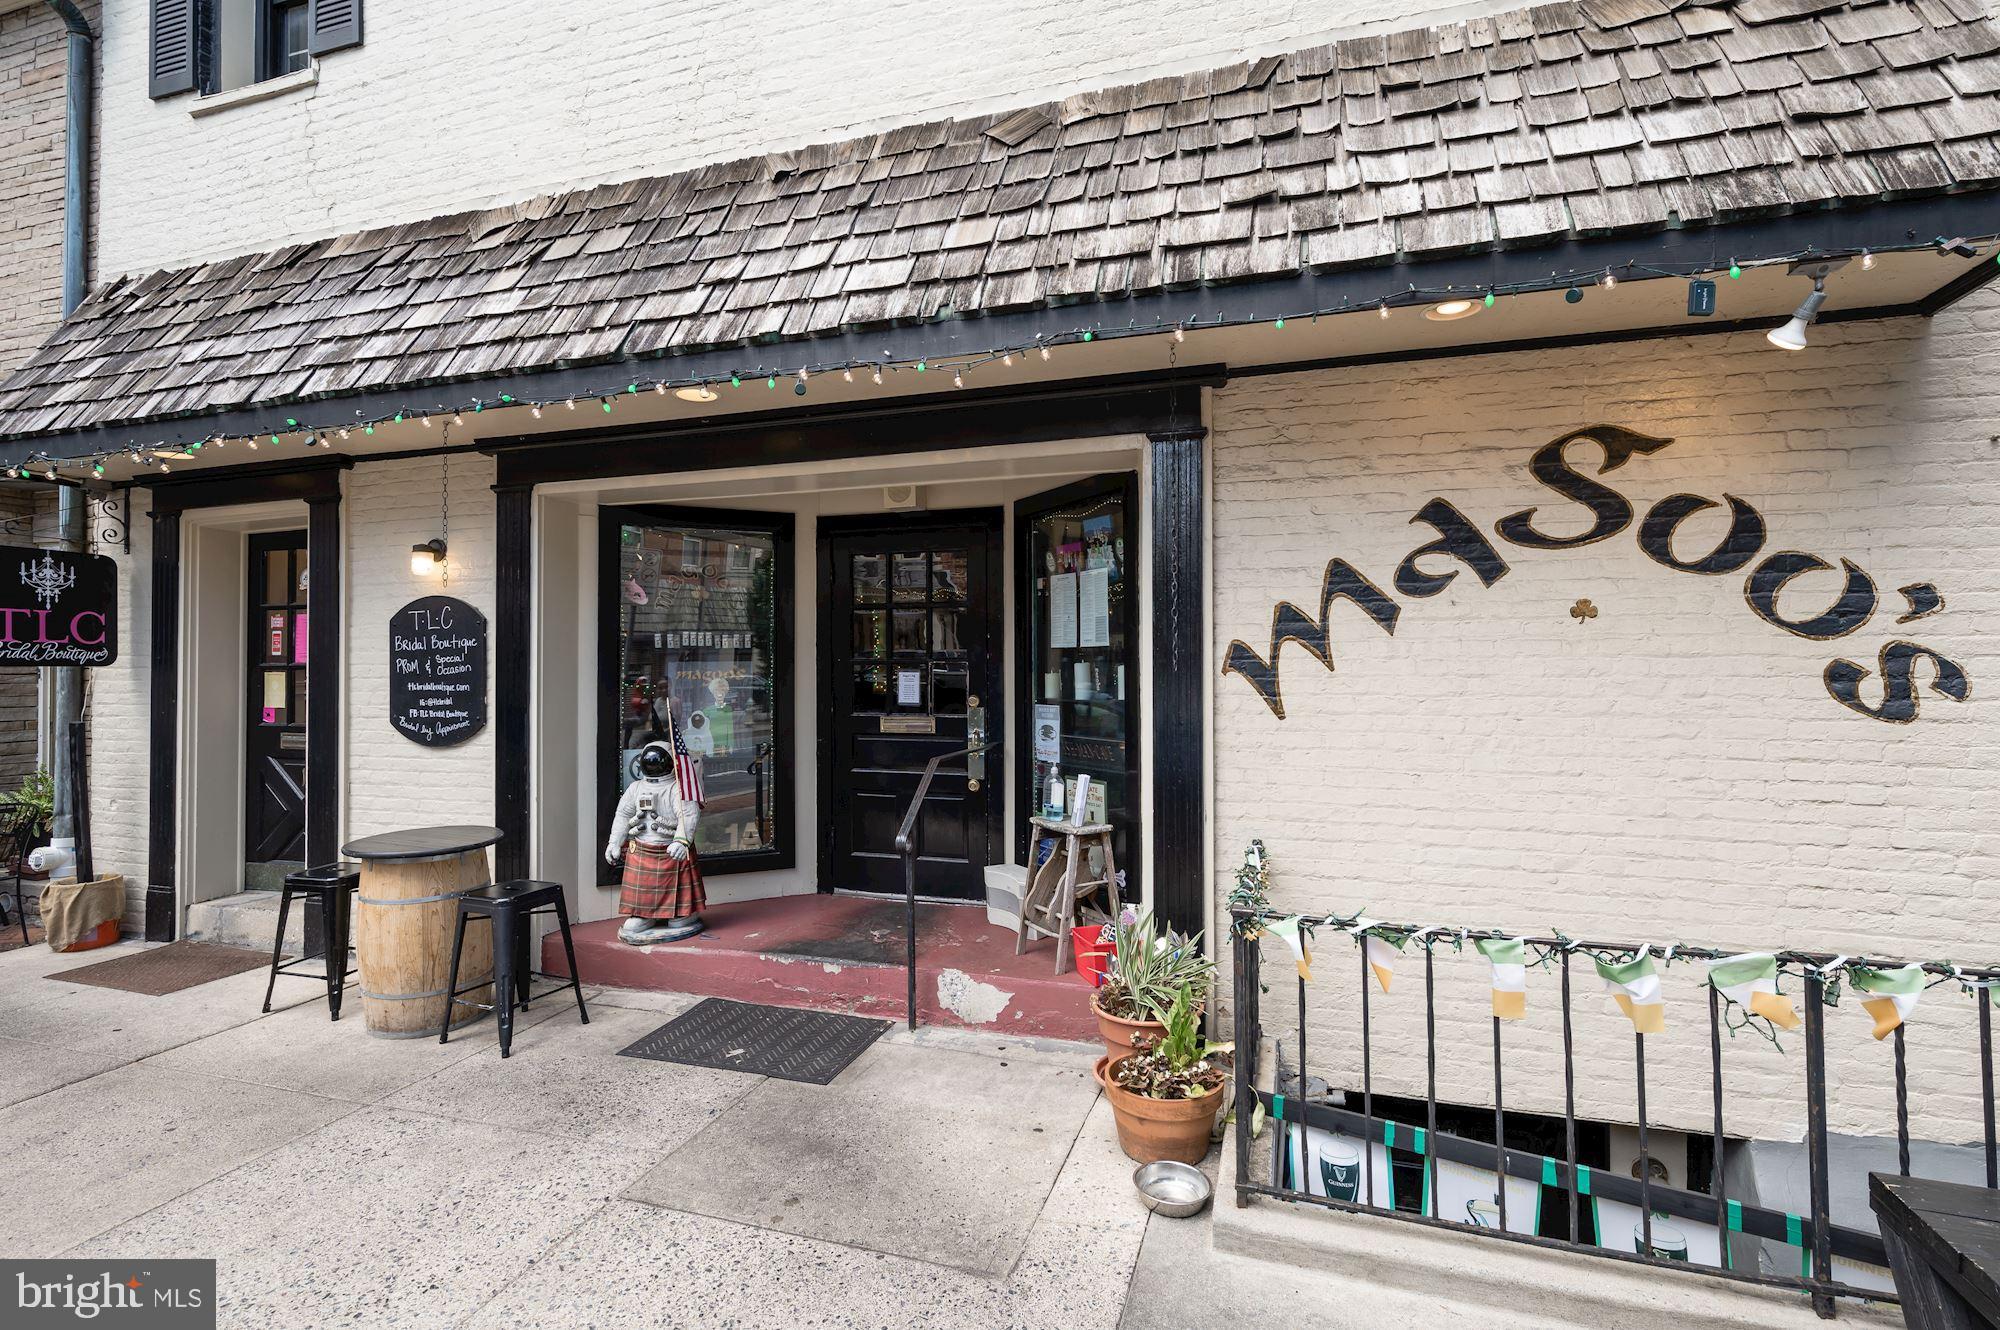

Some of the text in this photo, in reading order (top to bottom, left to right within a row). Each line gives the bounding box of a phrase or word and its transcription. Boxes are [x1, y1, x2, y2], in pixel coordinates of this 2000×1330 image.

[0, 608, 106, 645] TLC
[0, 641, 109, 665] ridal Boutique
[431, 634, 477, 654] Boutique
[1327, 1178, 1354, 1188] GUINNESS
